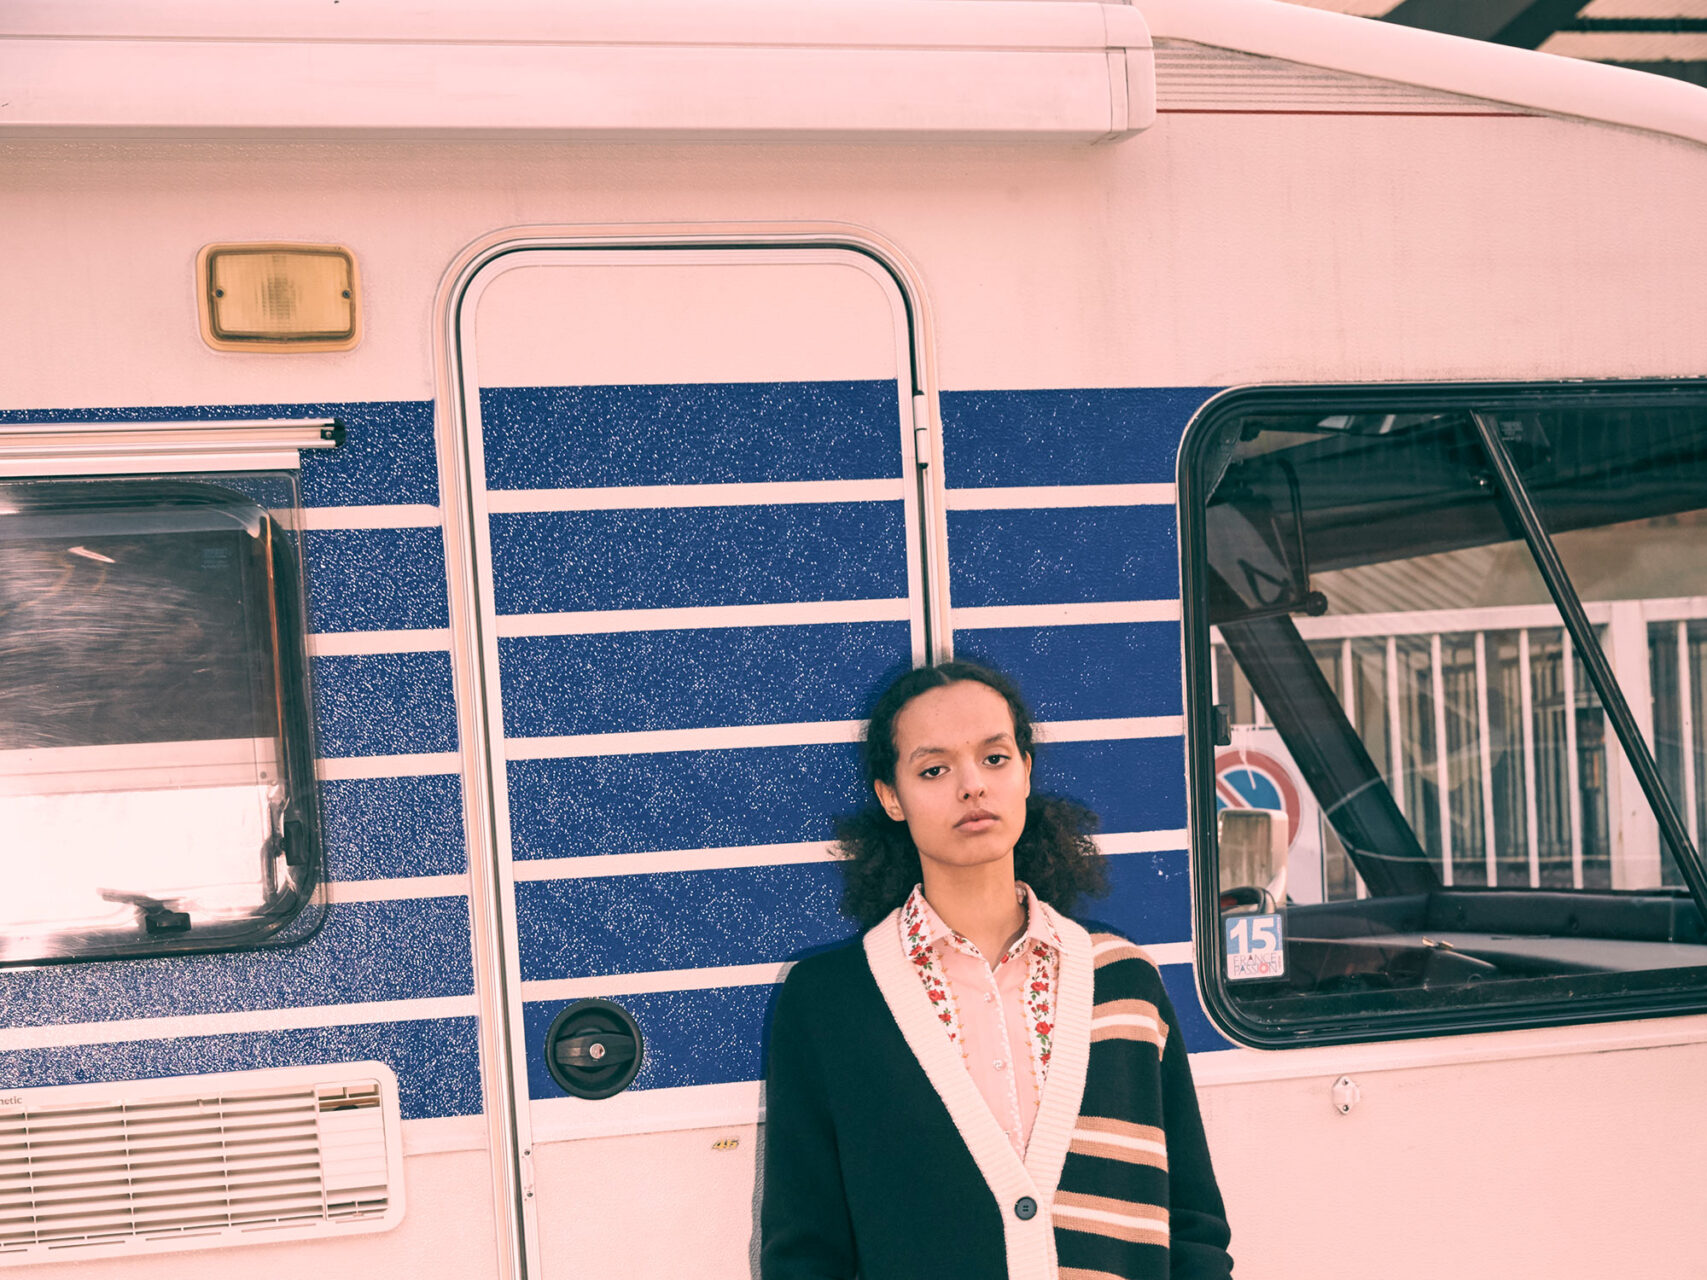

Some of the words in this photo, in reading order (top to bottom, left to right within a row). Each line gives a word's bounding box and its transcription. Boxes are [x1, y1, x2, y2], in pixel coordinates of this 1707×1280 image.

[1230, 917, 1276, 954] 15
[1233, 953, 1277, 966] FRANCE
[1233, 961, 1278, 976] PASSION
